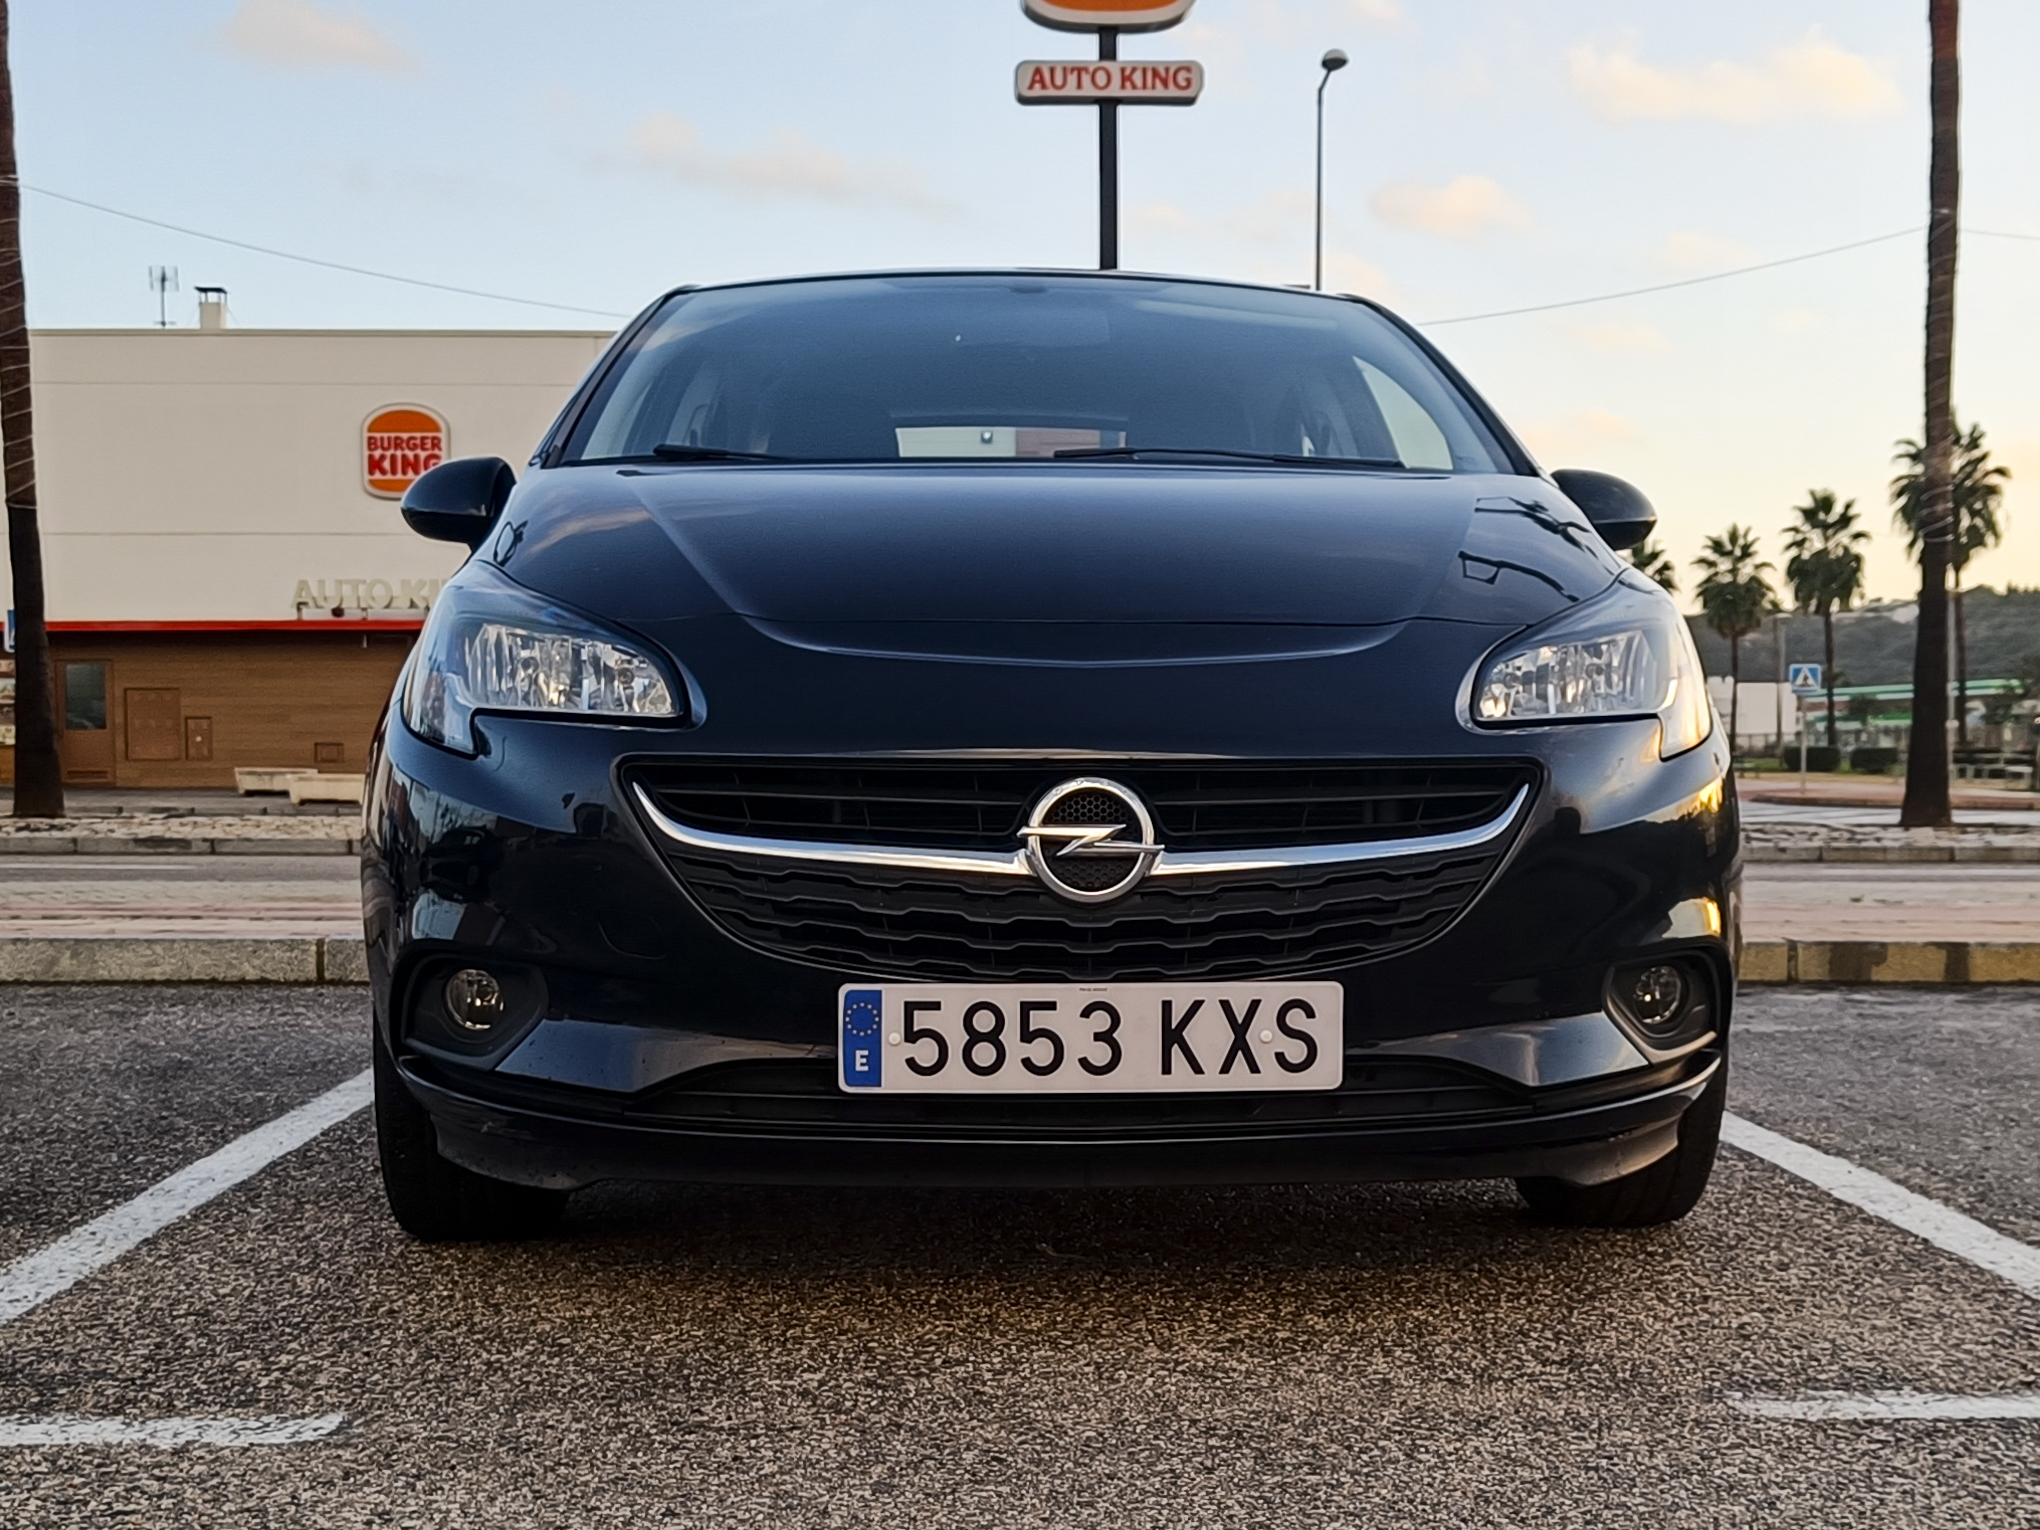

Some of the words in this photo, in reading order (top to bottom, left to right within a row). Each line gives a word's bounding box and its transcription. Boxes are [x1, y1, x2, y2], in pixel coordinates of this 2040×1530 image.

[1027, 66, 1113, 91] AUTO
[1119, 66, 1193, 91] KING
[367, 436, 442, 452] BURGER
[290, 579, 394, 610] AUTO
[400, 579, 447, 610] KI
[903, 1000, 1123, 1077] 5853
[1161, 998, 1319, 1076] KXS
[855, 1050, 869, 1071] E
